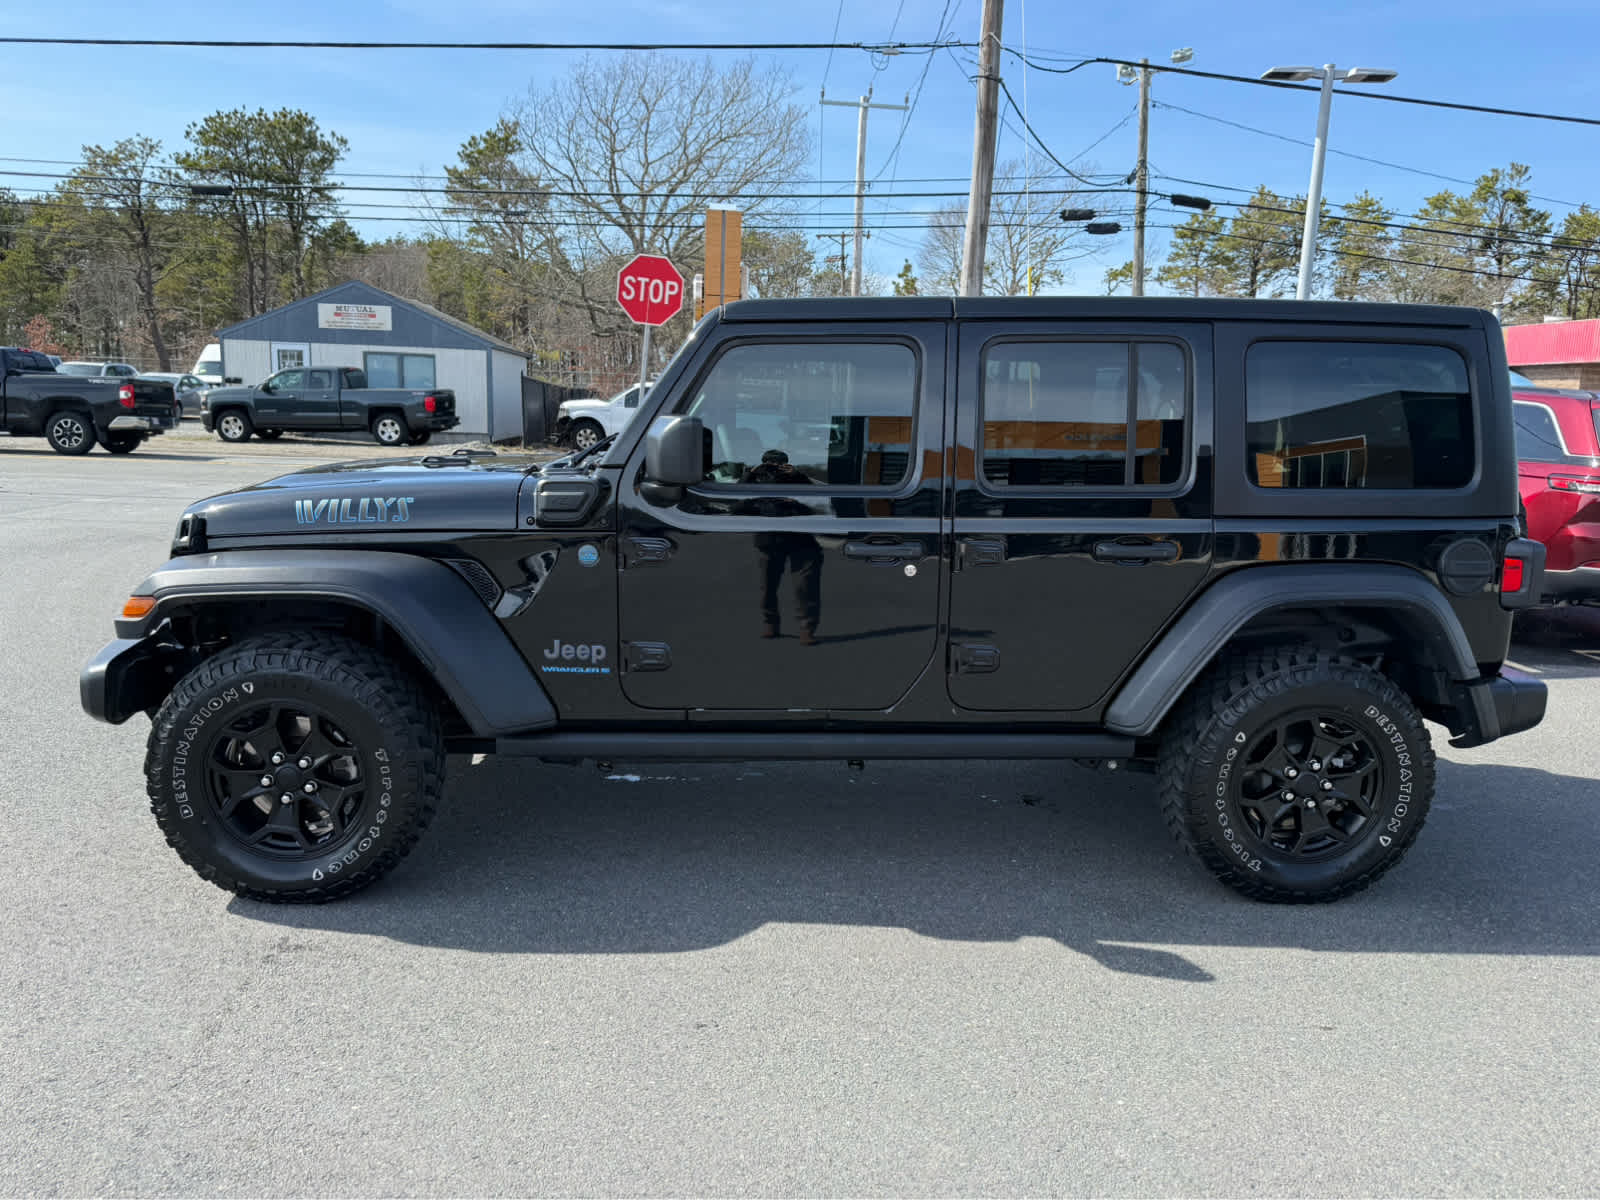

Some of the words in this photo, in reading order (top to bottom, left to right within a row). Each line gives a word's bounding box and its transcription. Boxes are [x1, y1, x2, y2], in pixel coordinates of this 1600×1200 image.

[622, 275, 679, 305] STOP
[295, 497, 415, 524] WILLYS
[543, 639, 607, 664] Jeep
[172, 687, 239, 819] DESTINATION
[1364, 704, 1412, 834] DESTINATION
